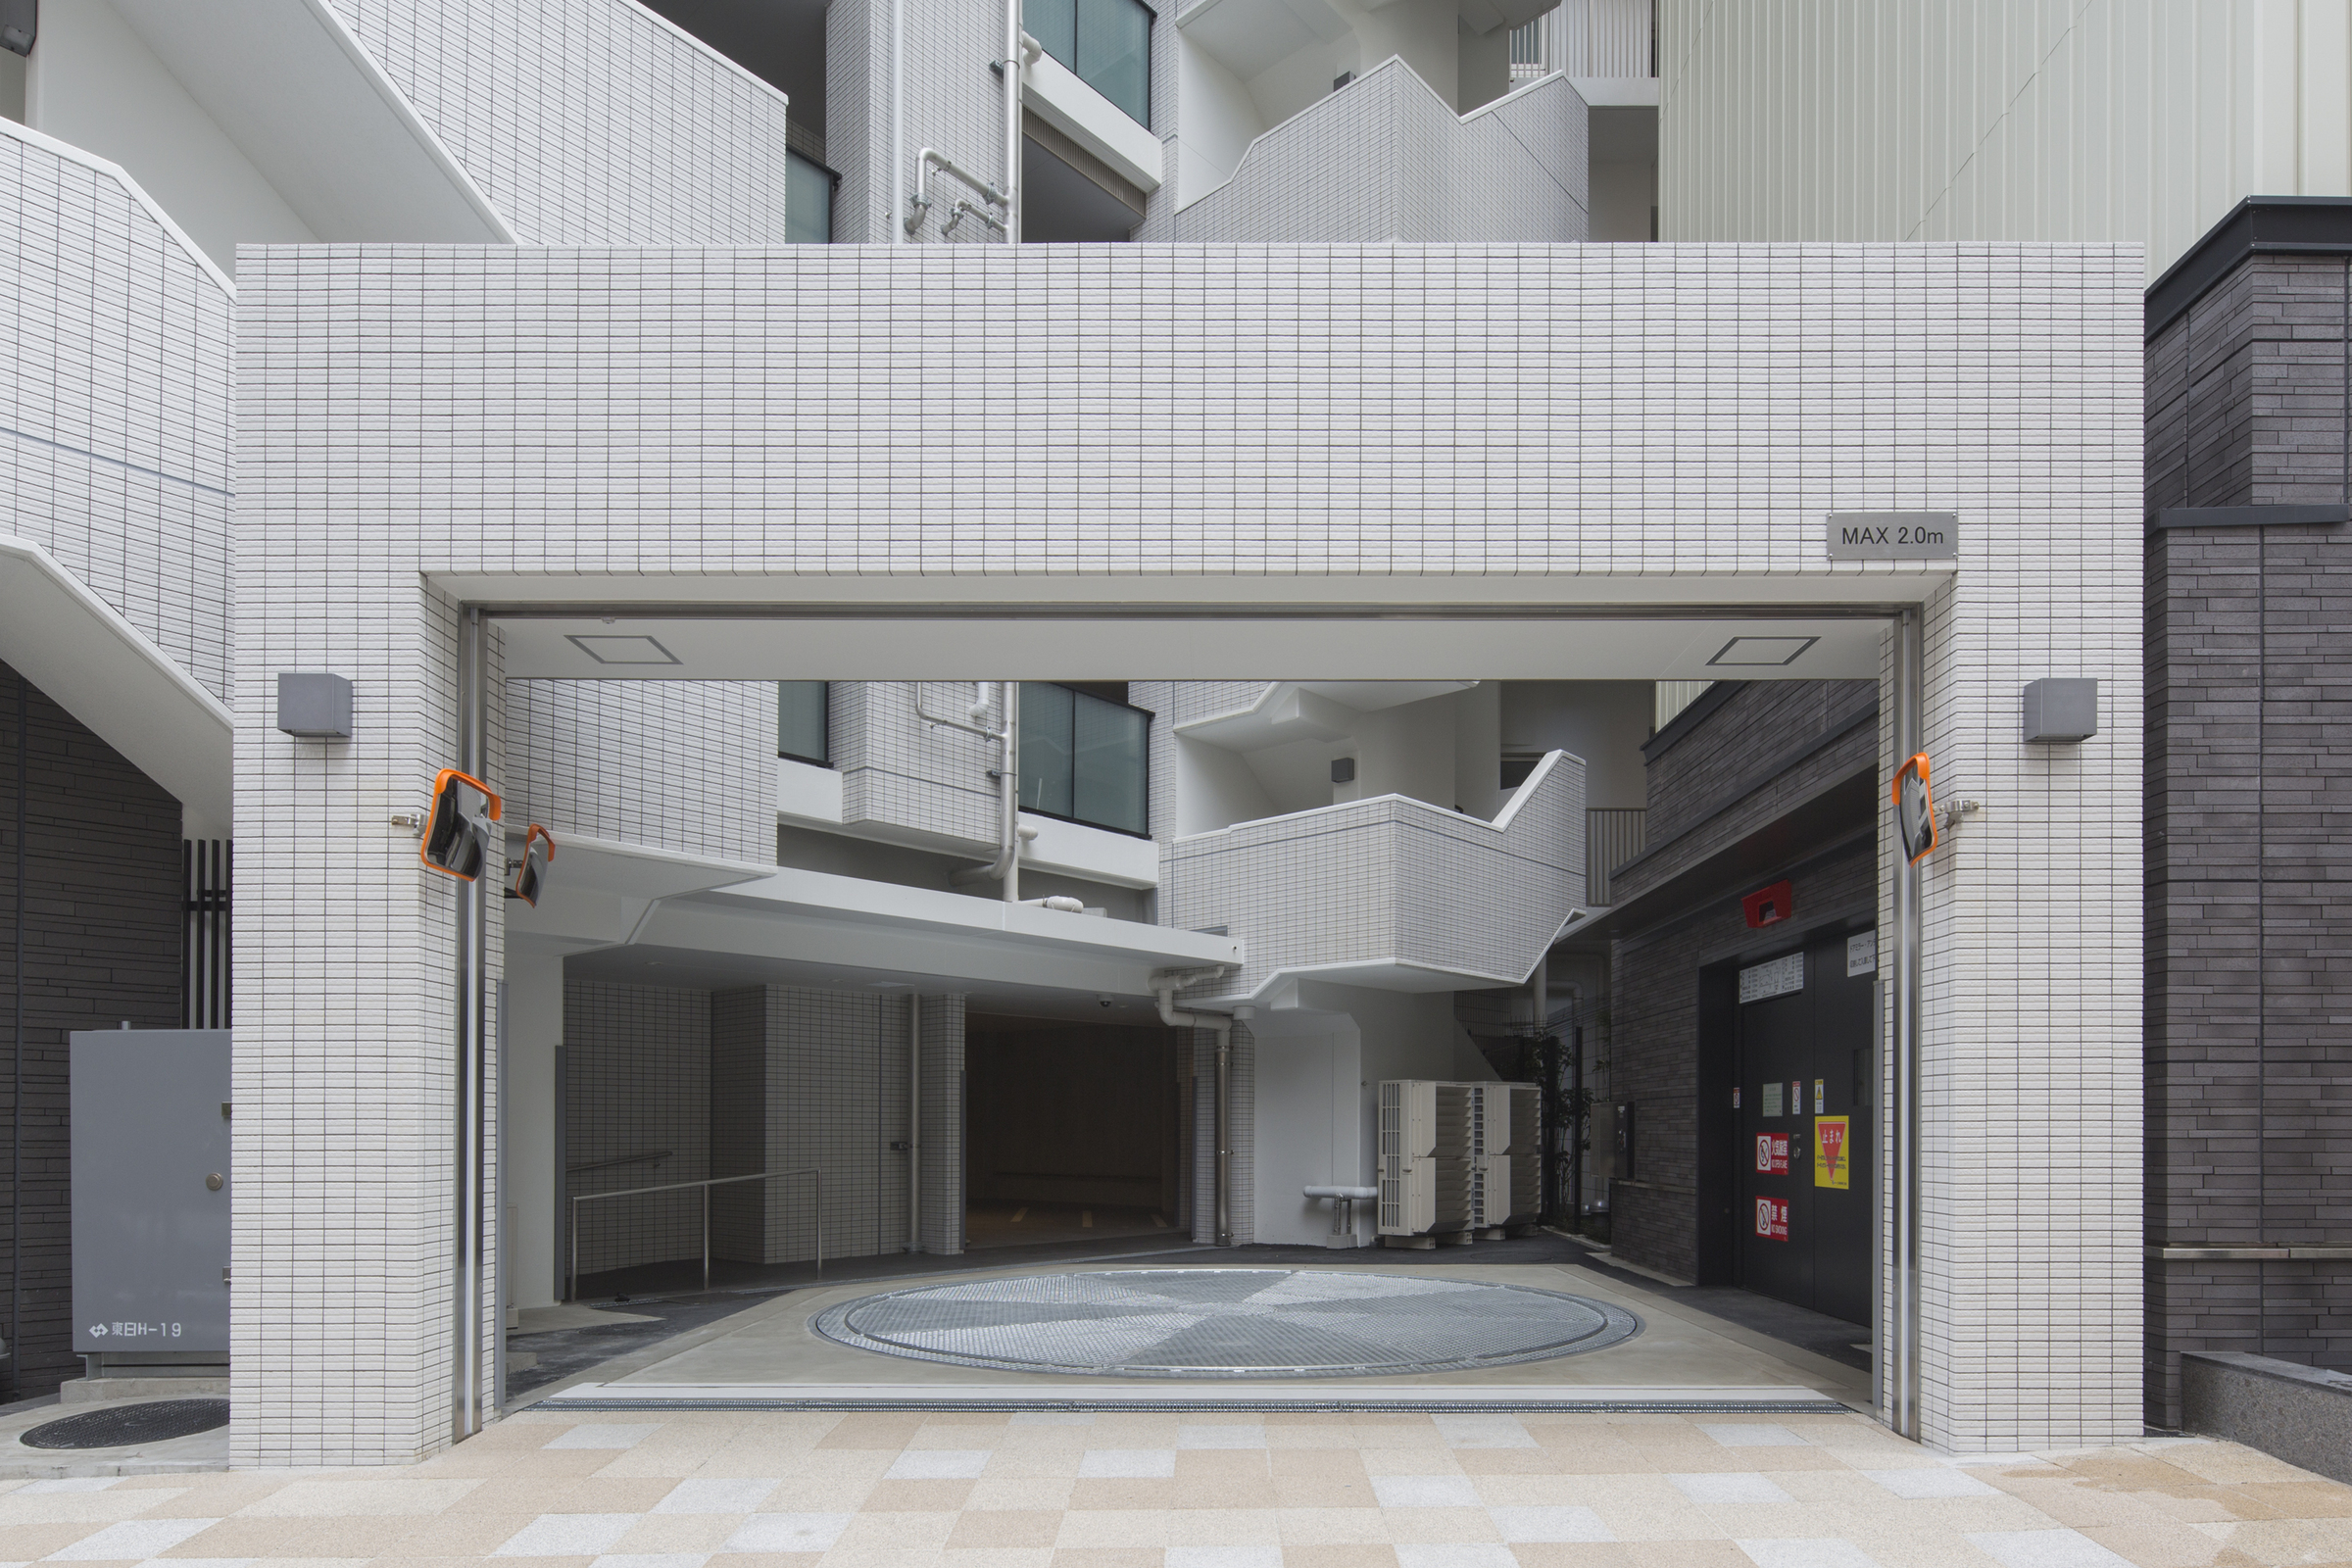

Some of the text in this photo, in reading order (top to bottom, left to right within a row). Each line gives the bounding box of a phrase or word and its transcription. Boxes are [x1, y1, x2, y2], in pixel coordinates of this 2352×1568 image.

[1842, 526, 1943, 545] MAX 2.0m
[1822, 1129, 1842, 1145] 止まれ
[1771, 1140, 1788, 1156] 火気厳禁
